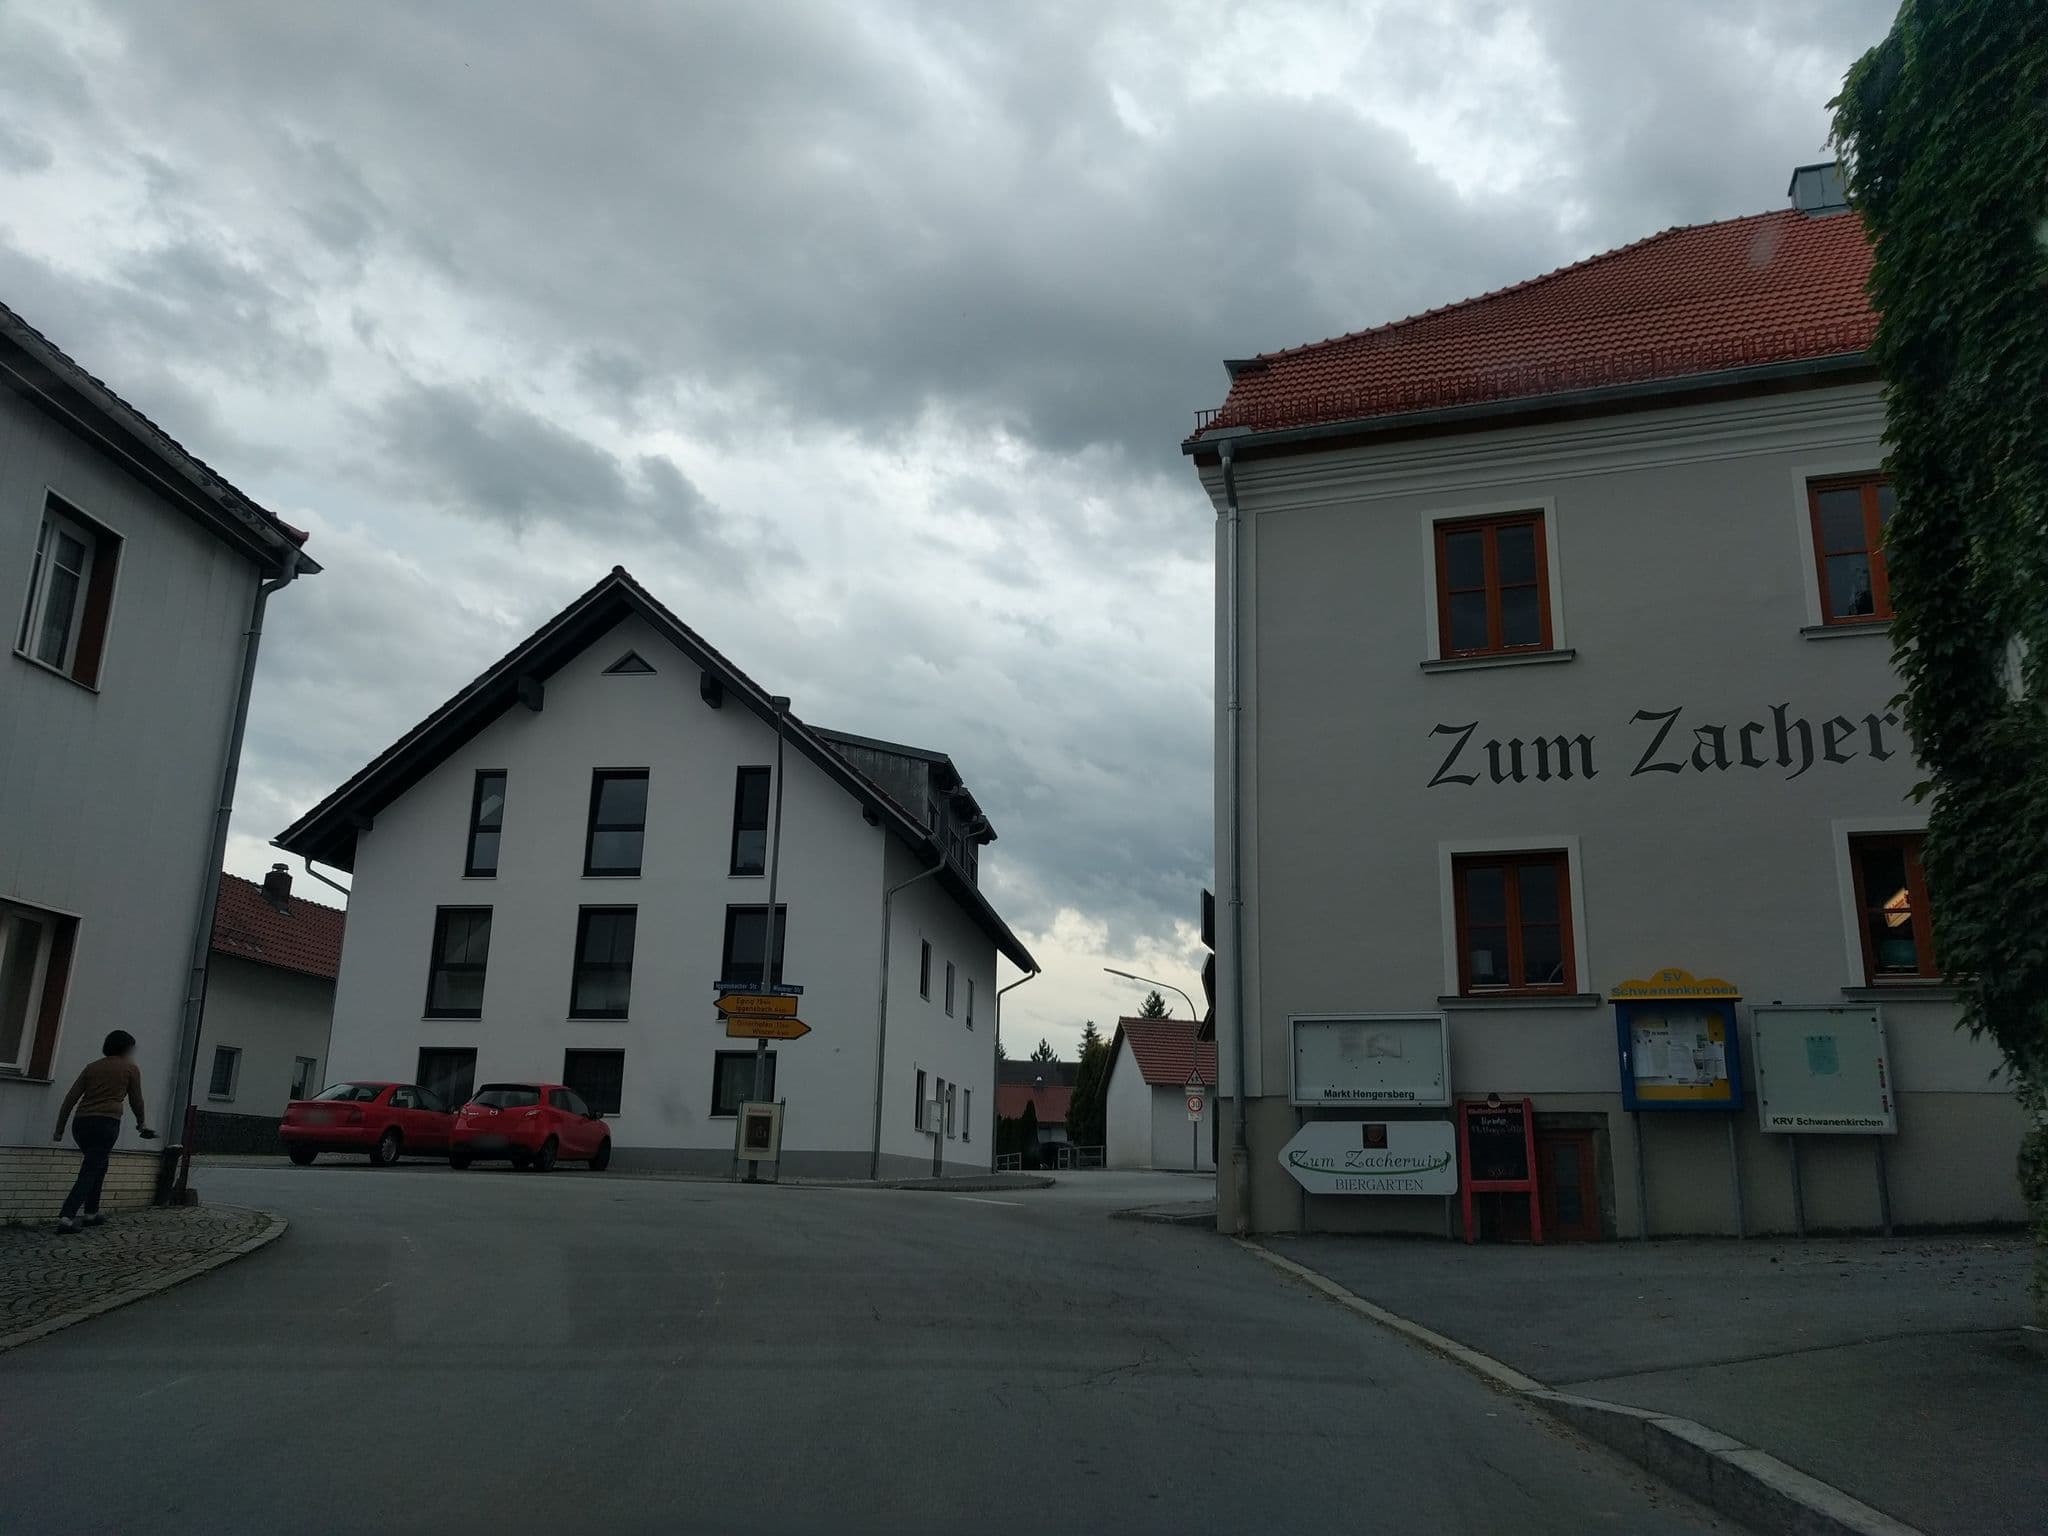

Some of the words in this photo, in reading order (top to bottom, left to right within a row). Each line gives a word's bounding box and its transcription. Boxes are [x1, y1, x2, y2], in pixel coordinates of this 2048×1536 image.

[1426, 720, 1599, 788] Zum
[1611, 985, 1738, 996] Schwanenkirchen
[736, 1004, 772, 1013] Iggensbach
[1324, 1089, 1351, 1098] Markt
[1353, 1089, 1415, 1100] Hengersberg
[1191, 1100, 1200, 1108] 30
[1772, 1117, 1794, 1126] KRV
[1797, 1117, 1884, 1127] Schwanenkirchen
[1288, 1150, 1335, 1168] Zum
[1345, 1150, 1451, 1173] Zacherwirt
[1335, 1178, 1424, 1191] BIERGARTEN
